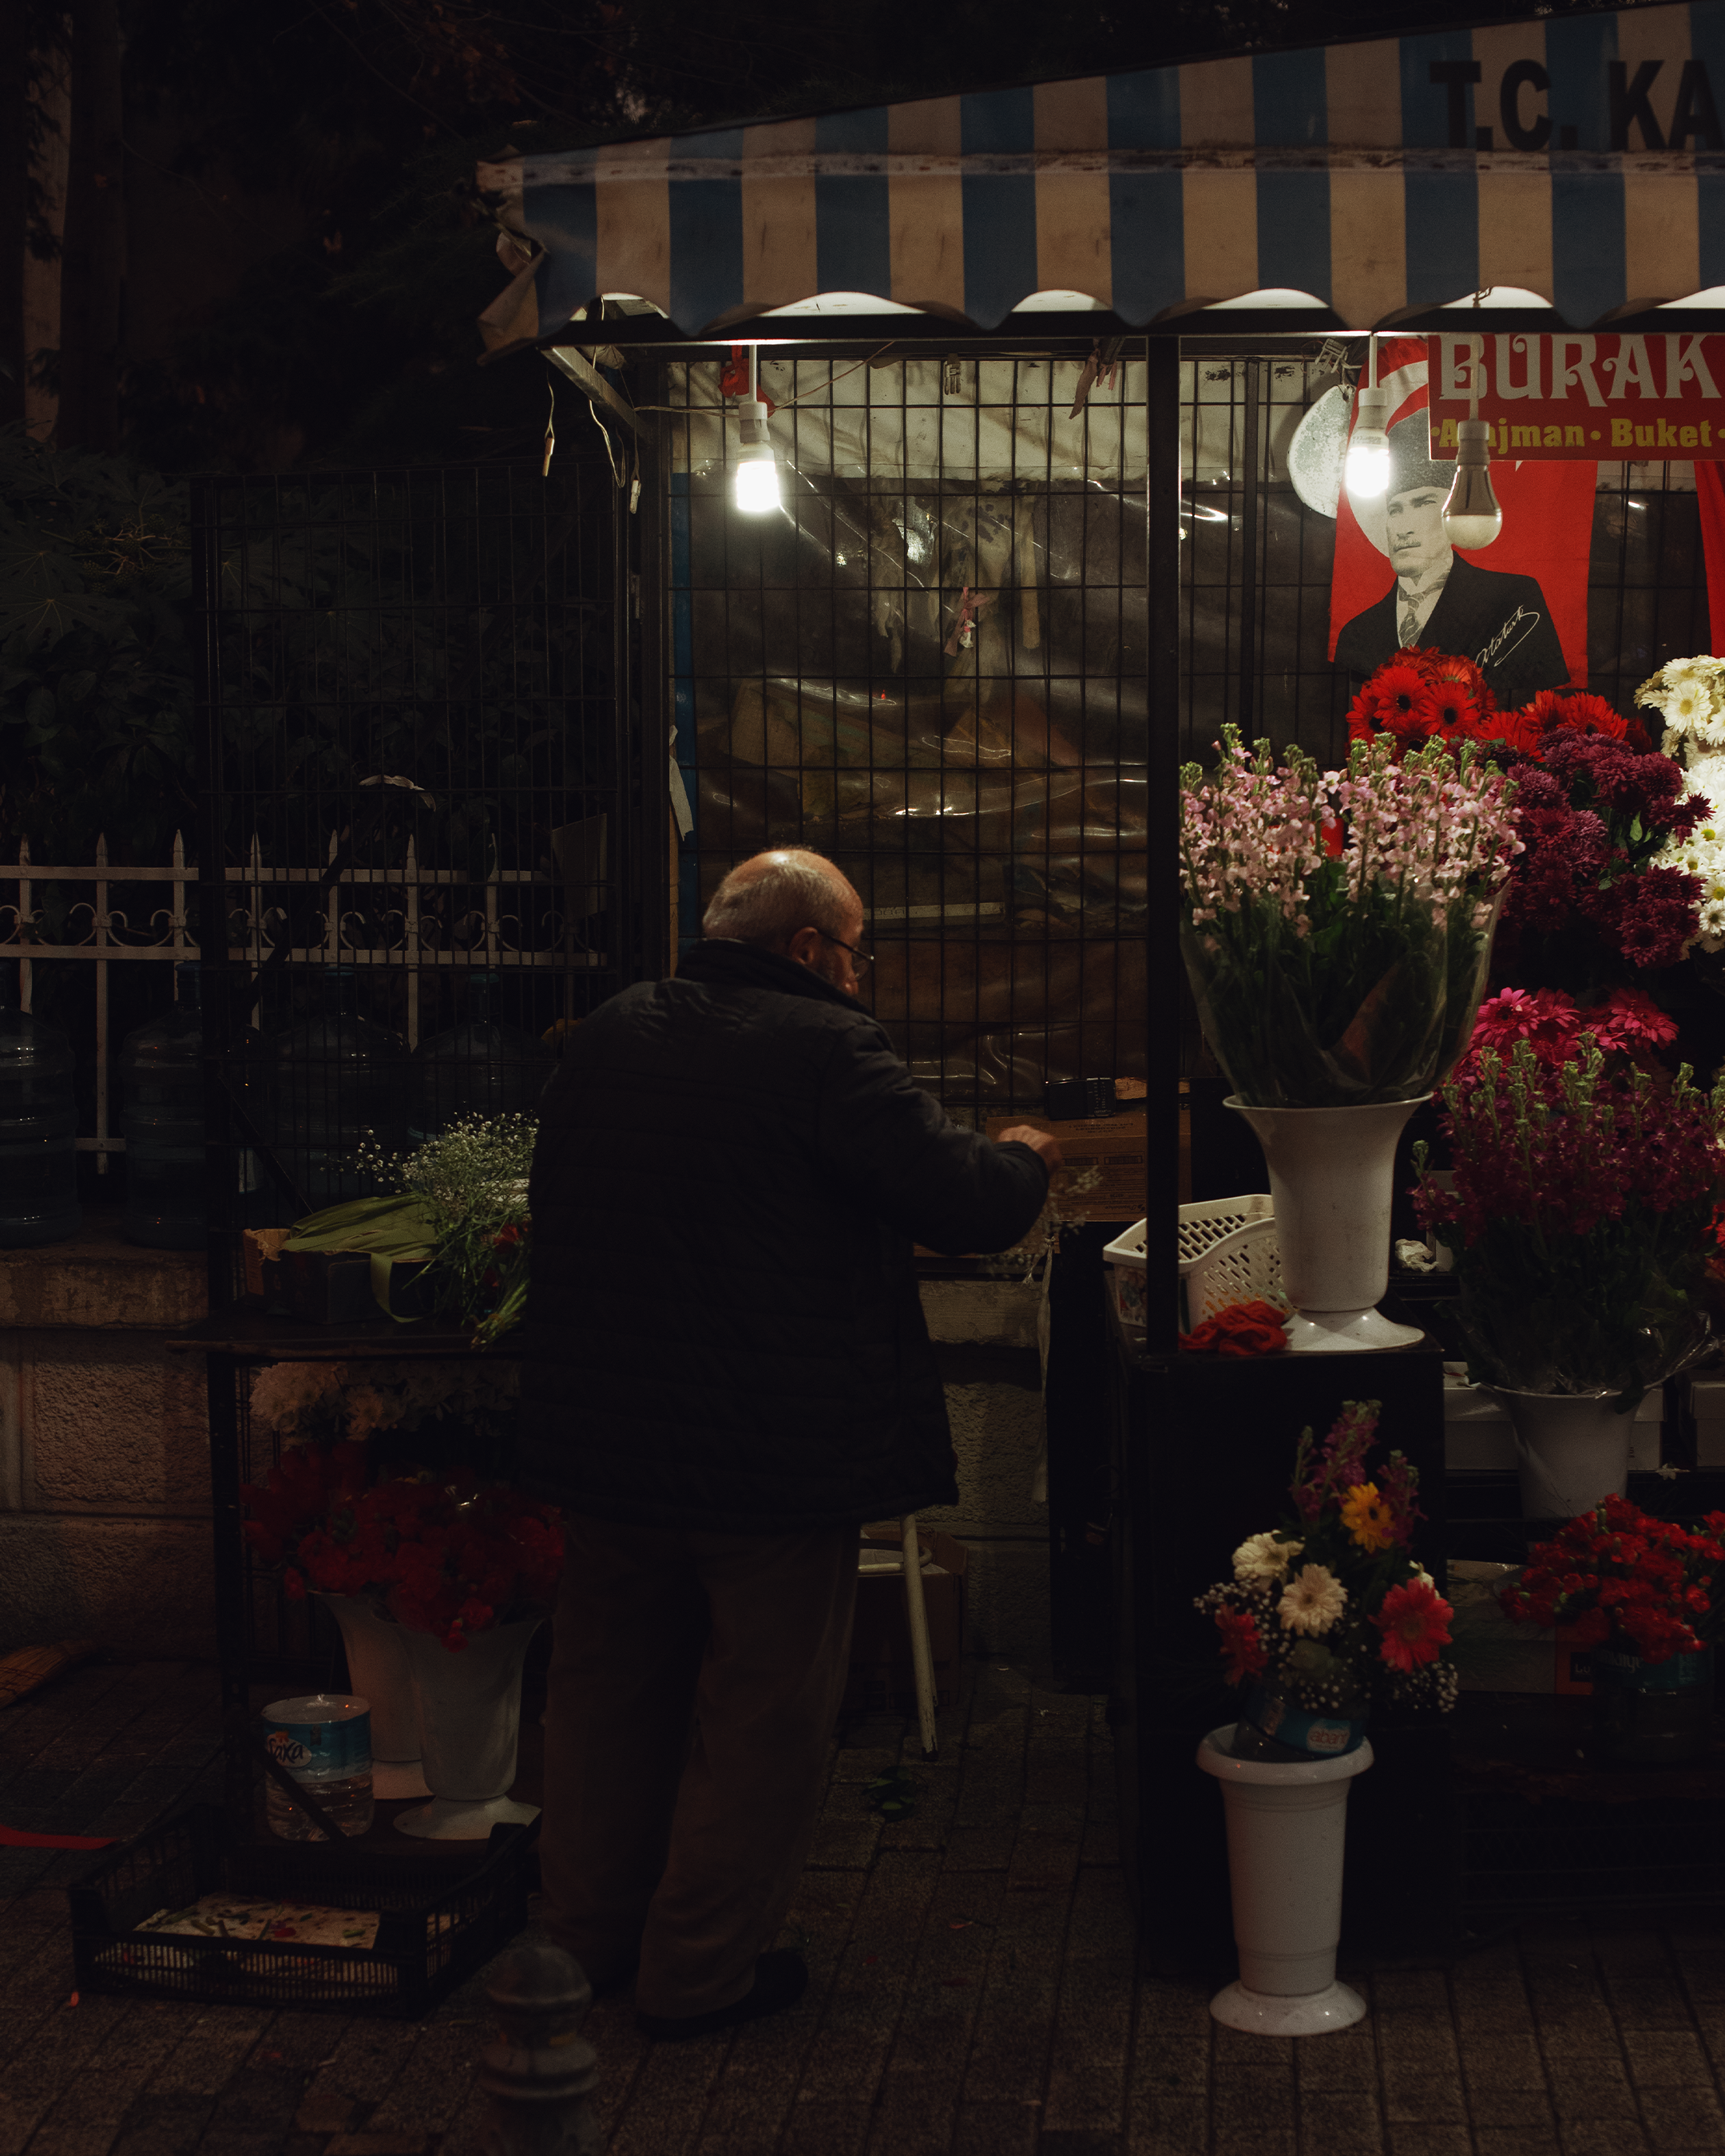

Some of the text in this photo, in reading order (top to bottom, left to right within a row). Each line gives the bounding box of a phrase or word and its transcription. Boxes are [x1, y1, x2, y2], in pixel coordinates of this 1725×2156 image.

[1430, 59, 1579, 152] T.C.
[1438, 334, 1723, 407] BURAK
[1611, 418, 1712, 447] Buket
